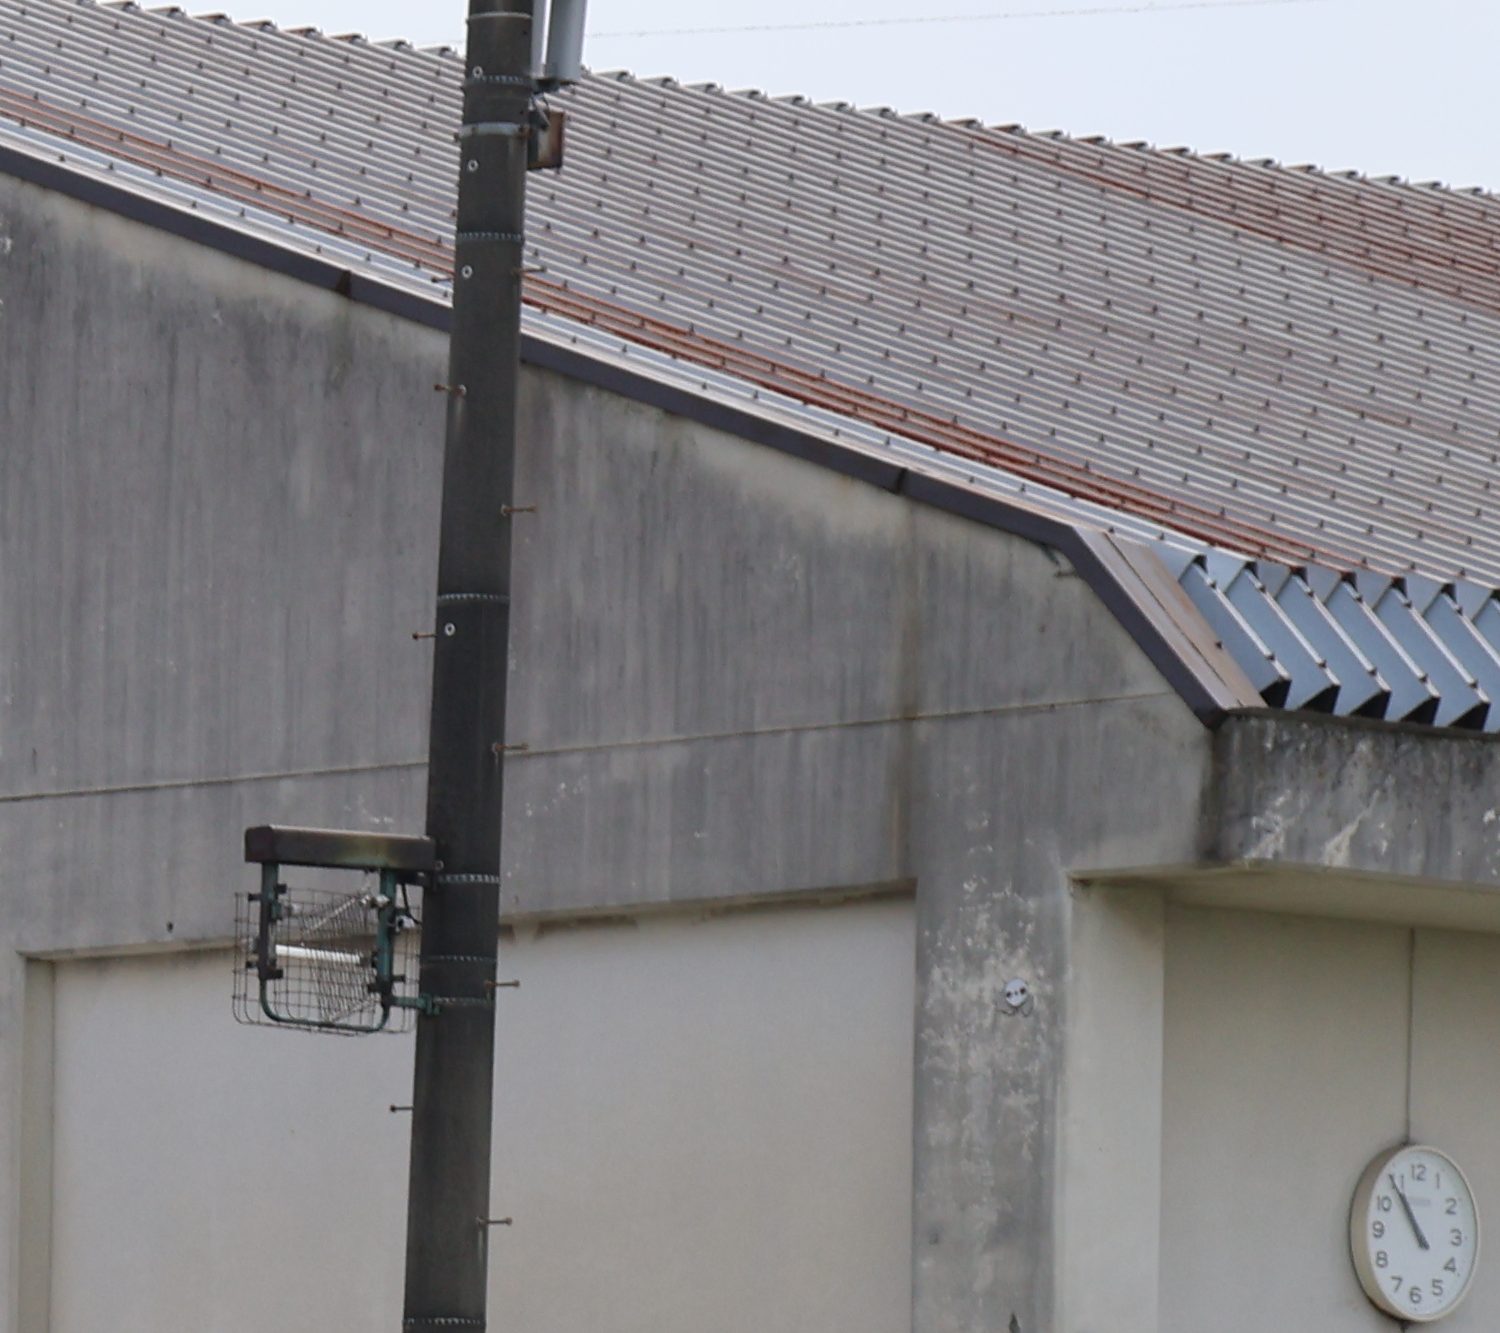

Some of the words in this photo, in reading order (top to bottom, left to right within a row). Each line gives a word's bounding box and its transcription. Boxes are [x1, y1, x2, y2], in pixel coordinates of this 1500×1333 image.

[1411, 1163, 1427, 1182] 12
[1377, 1195, 1392, 1212] 10
[1444, 1198, 1457, 1215] 2
[1372, 1220, 1385, 1238] 9
[1450, 1228, 1462, 1246] 3
[1375, 1251, 1388, 1268] 8
[1443, 1256, 1457, 1273] 4
[1390, 1275, 1403, 1292] 7
[1431, 1278, 1444, 1296] 5
[1409, 1286, 1422, 1304] 6
